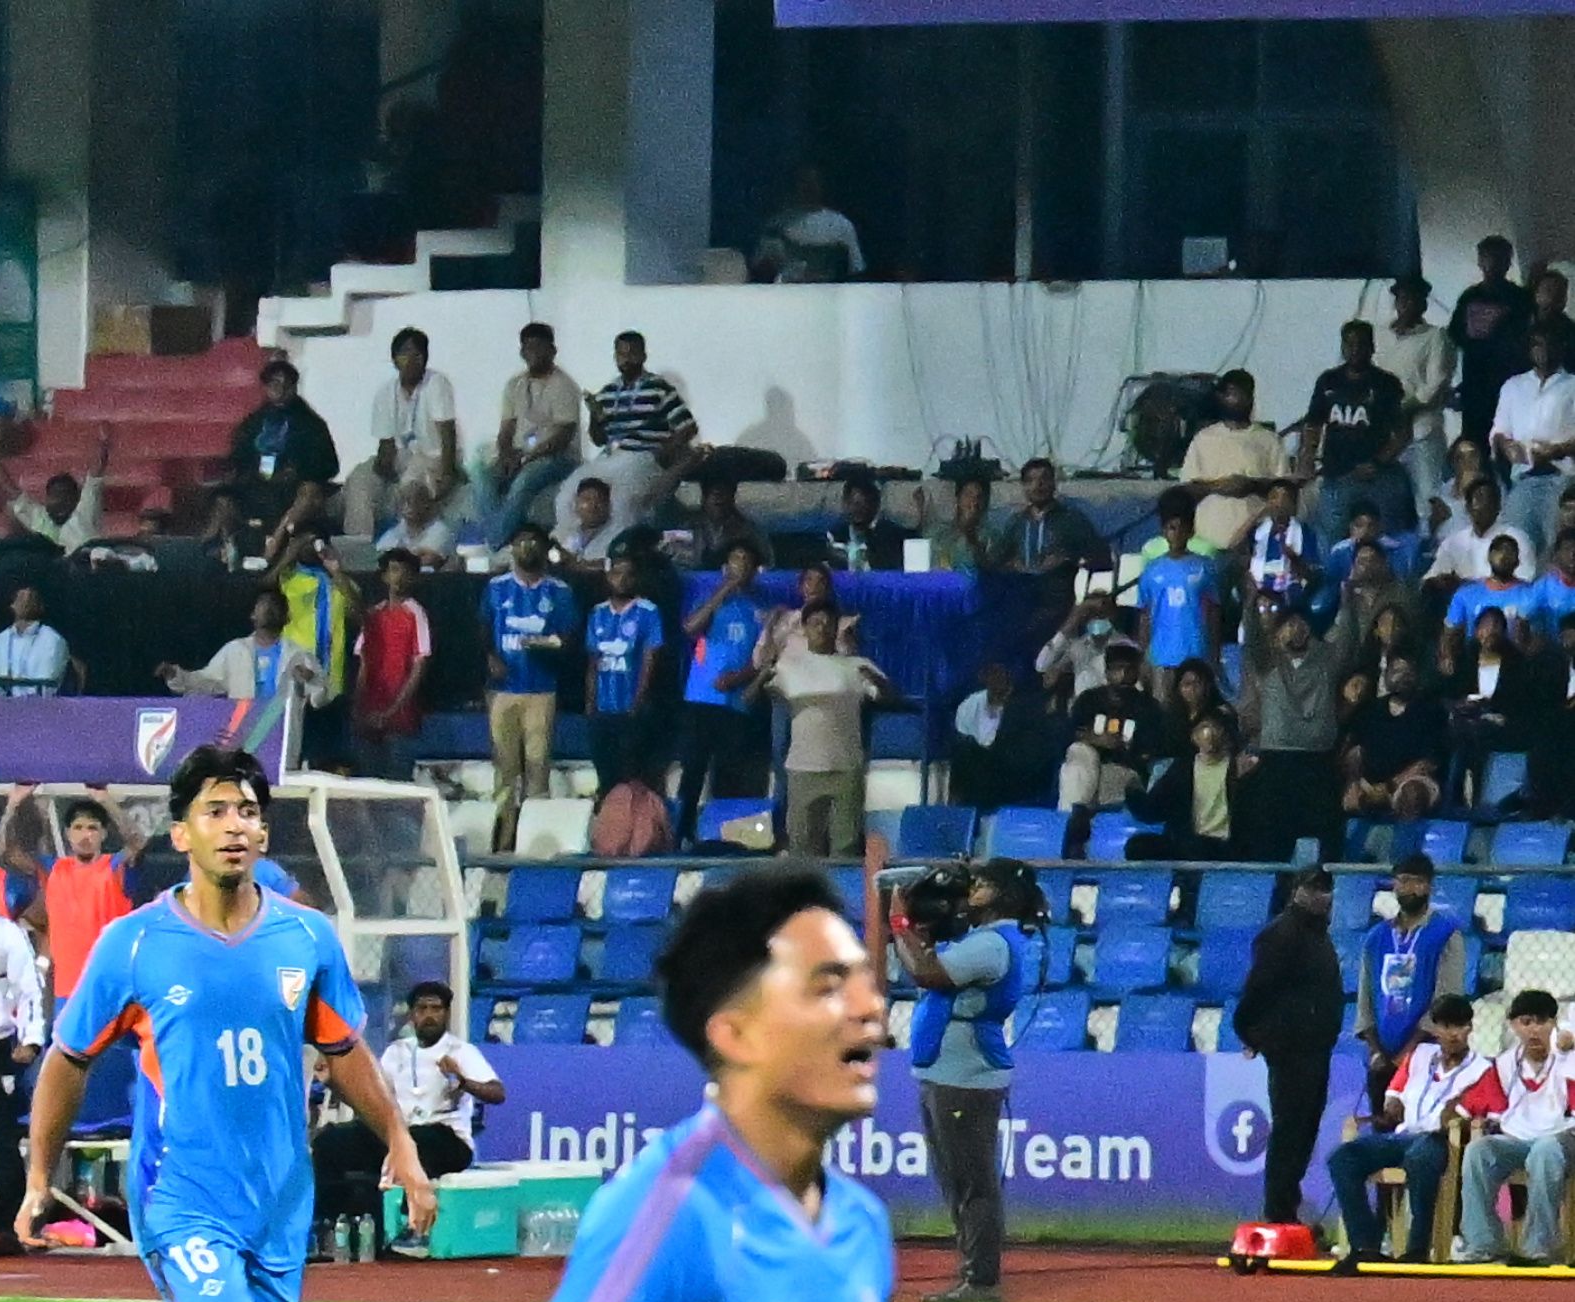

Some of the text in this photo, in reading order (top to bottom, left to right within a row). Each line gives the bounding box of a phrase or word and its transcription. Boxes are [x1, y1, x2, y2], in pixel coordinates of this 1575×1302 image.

[216, 1027, 268, 1087] 18
[530, 1110, 666, 1169] Indi
[997, 1118, 1151, 1180] Team
